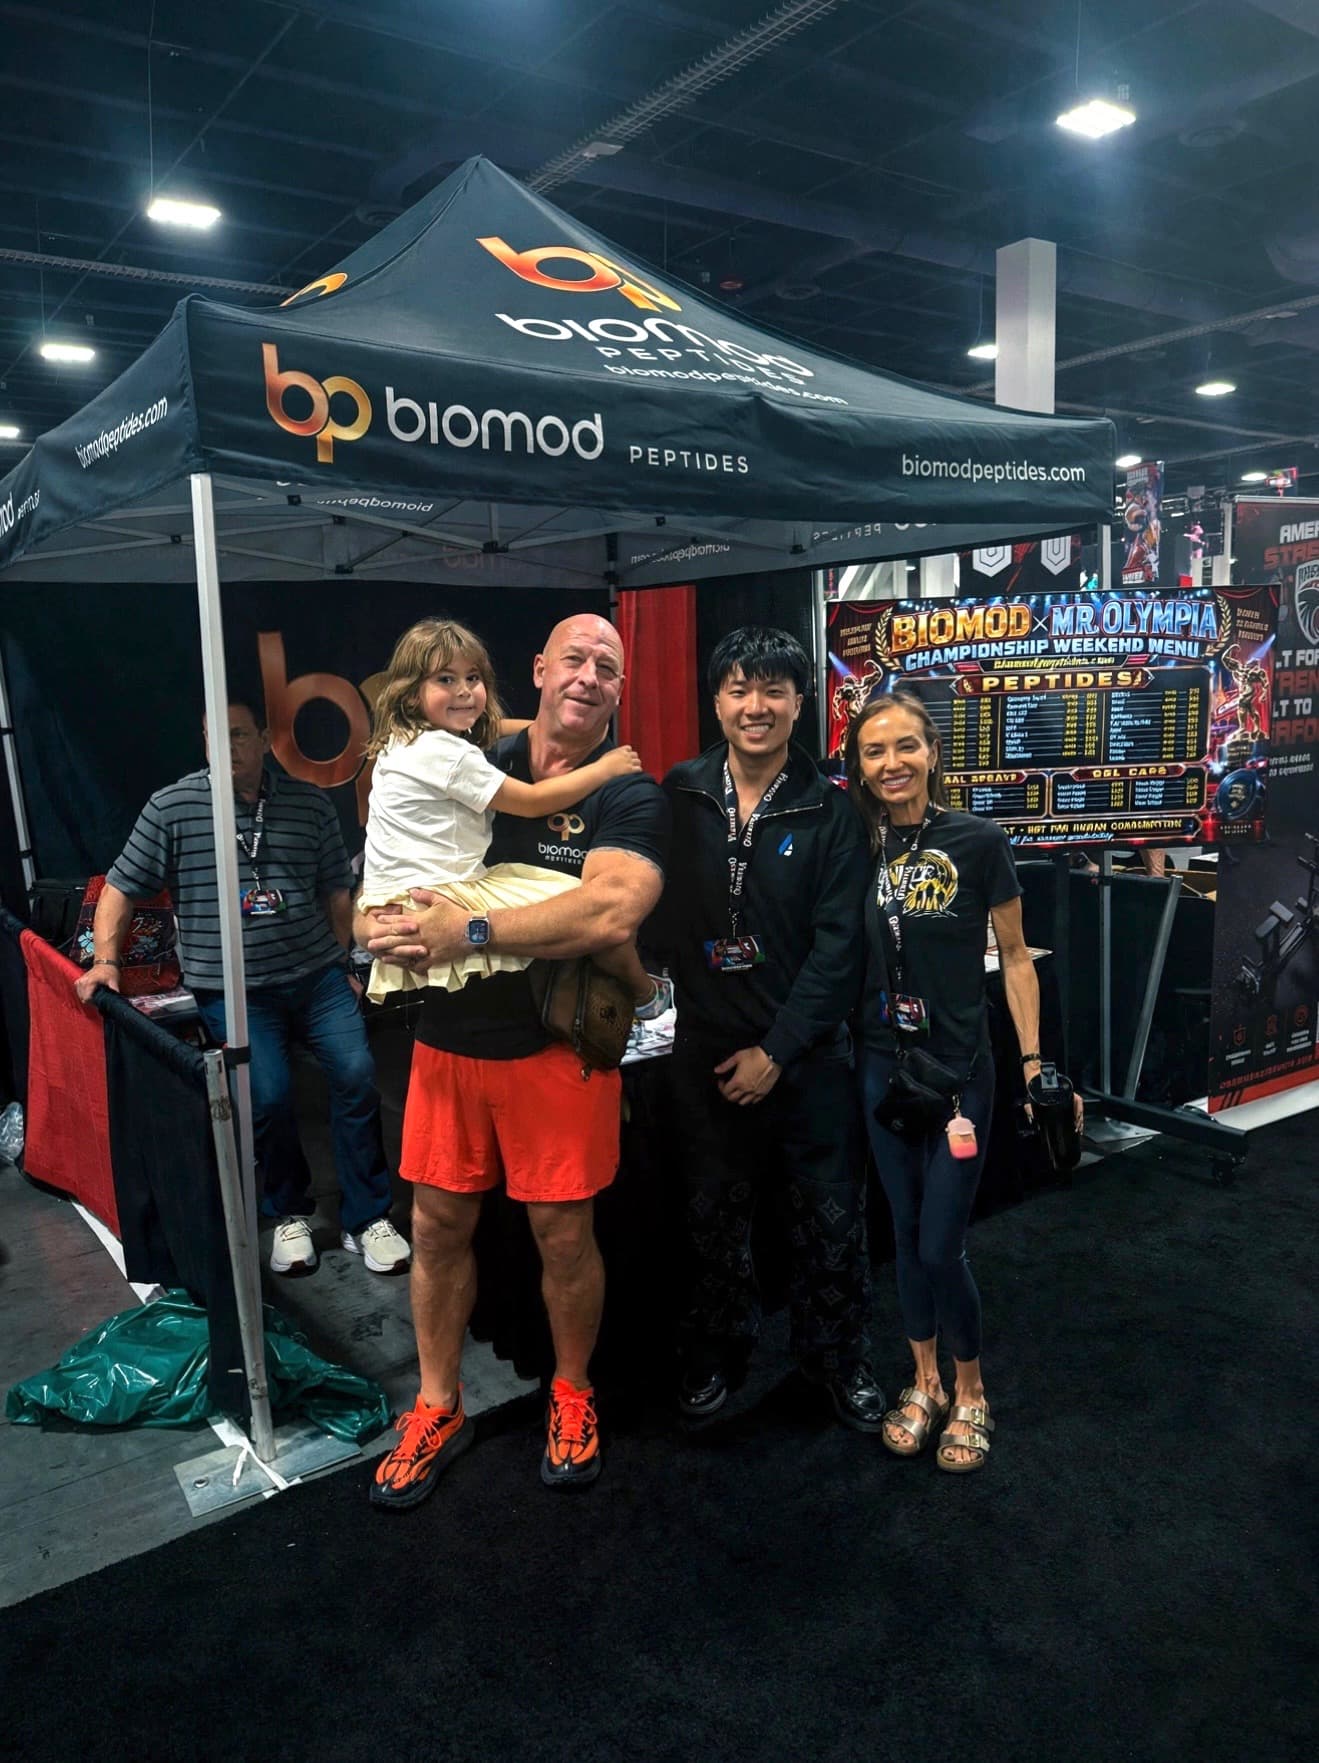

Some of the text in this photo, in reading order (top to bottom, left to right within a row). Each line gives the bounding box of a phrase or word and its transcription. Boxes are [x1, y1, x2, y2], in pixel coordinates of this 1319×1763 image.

[495, 313, 815, 377] biomod
[596, 346, 806, 386] PEPTIDES
[604, 365, 848, 405] biomodpeptides.com
[74, 396, 168, 469] biomodpeptides.com
[385, 386, 604, 461] biomod
[629, 446, 750, 475] PEPTIDES
[902, 454, 1086, 483] biomodpeptides.com
[891, 604, 1032, 653] BIOMOD
[1051, 603, 1099, 636] MR.
[1102, 600, 1218, 640] OLYMPIA
[905, 639, 1049, 672] CHAMPIONSHIP
[1054, 637, 1144, 655] WEEKEND
[1148, 639, 1200, 659] MENU
[982, 671, 1132, 691] PEPTIDES
[1294, 698, 1312, 715] TO
